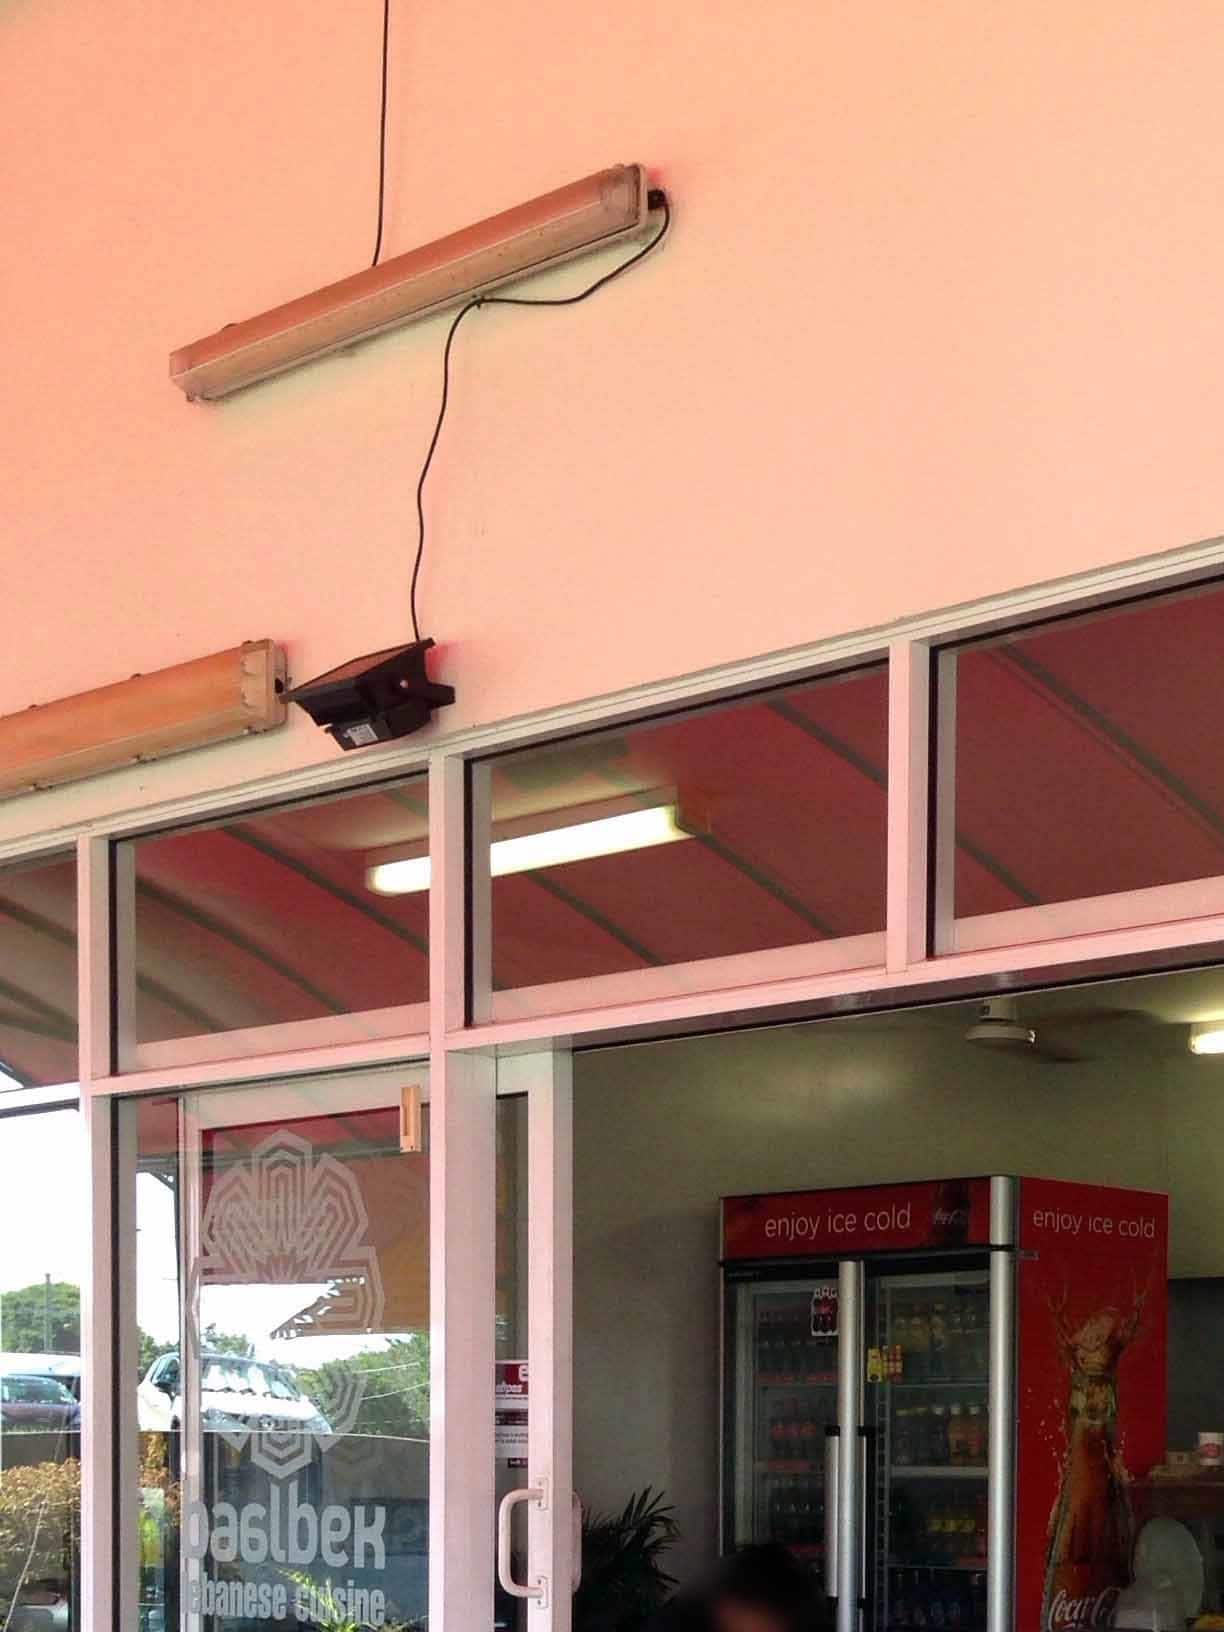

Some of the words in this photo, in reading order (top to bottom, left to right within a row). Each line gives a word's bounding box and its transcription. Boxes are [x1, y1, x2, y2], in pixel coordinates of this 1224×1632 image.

[764, 1211, 820, 1241] enjoy
[827, 1207, 857, 1233] ice
[863, 1201, 912, 1232] cold
[1032, 1207, 1082, 1236] enjoy
[1088, 1213, 1113, 1234] ice
[1118, 1215, 1156, 1239] cold
